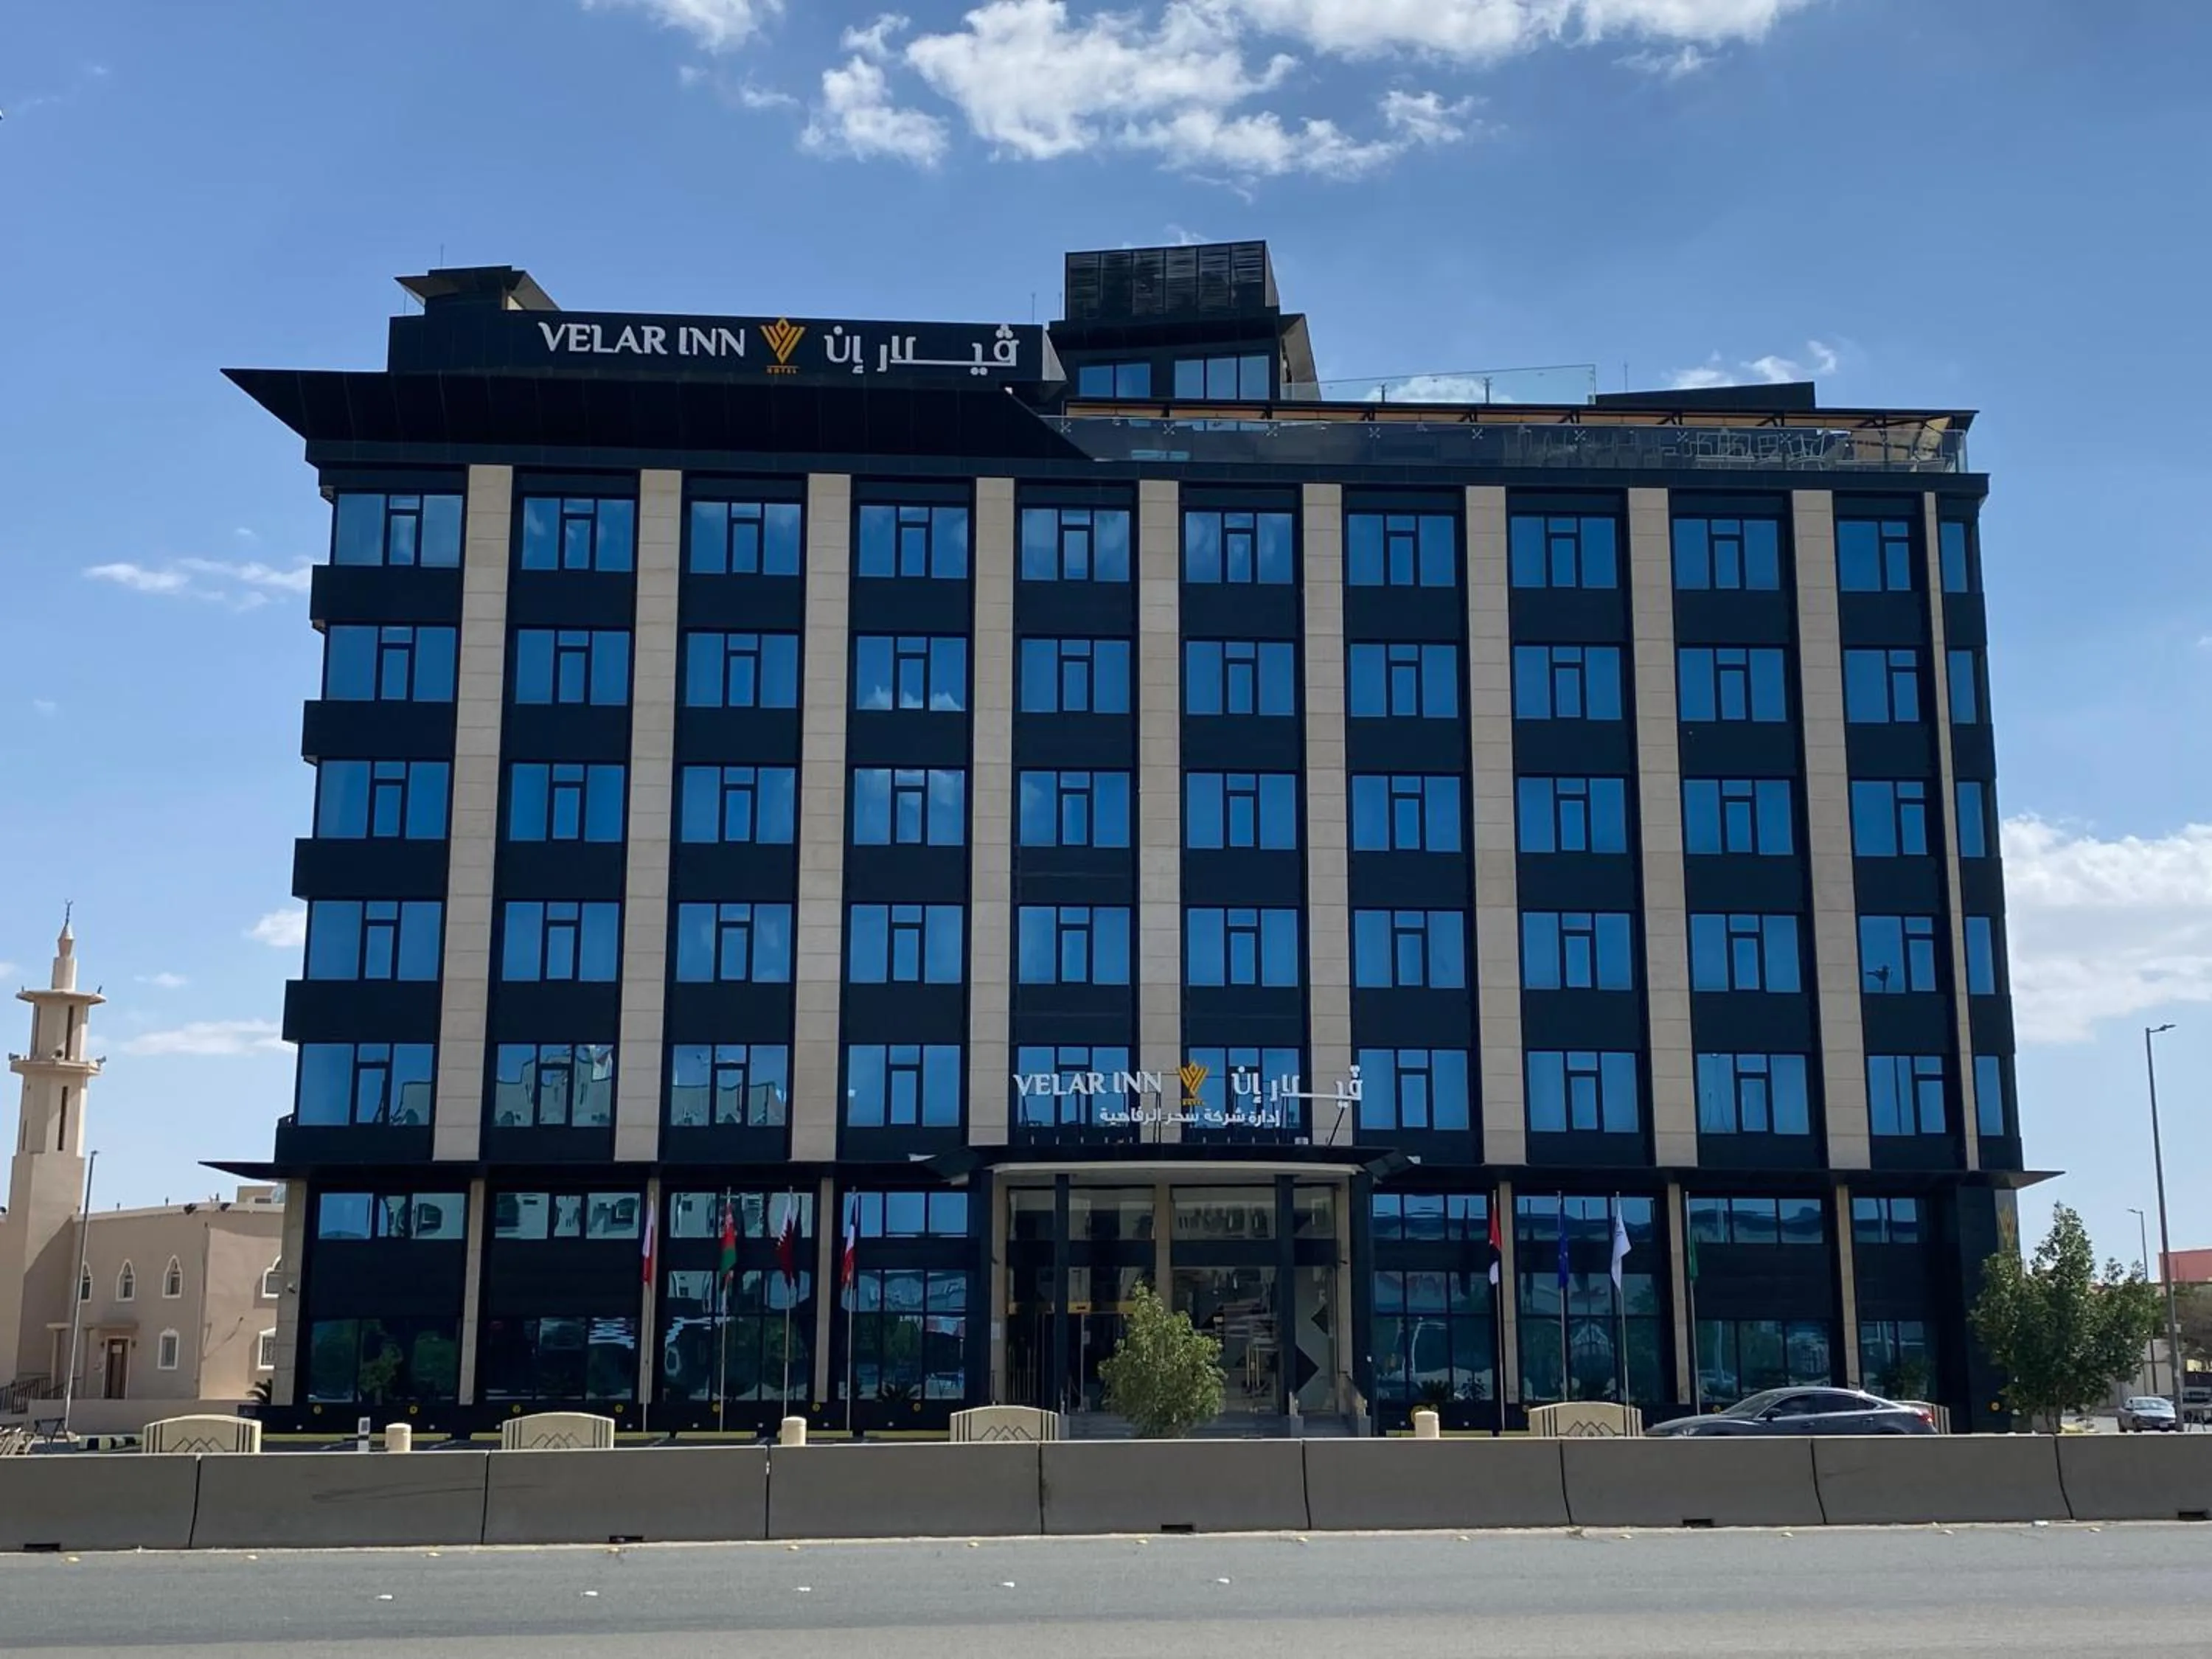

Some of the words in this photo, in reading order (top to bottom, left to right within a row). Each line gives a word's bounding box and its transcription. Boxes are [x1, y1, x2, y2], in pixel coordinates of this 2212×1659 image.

[538, 321, 669, 355] VELAR
[678, 327, 746, 357] INN
[824, 325, 863, 374] إن
[1012, 1071, 1107, 1096] VELAR
[1113, 1071, 1162, 1093] INN
[1231, 1065, 1262, 1104] إن
[1099, 1106, 1161, 1126] الرفاهية
[1204, 1107, 1245, 1126] شركة
[1248, 1108, 1281, 1127] إدارة
